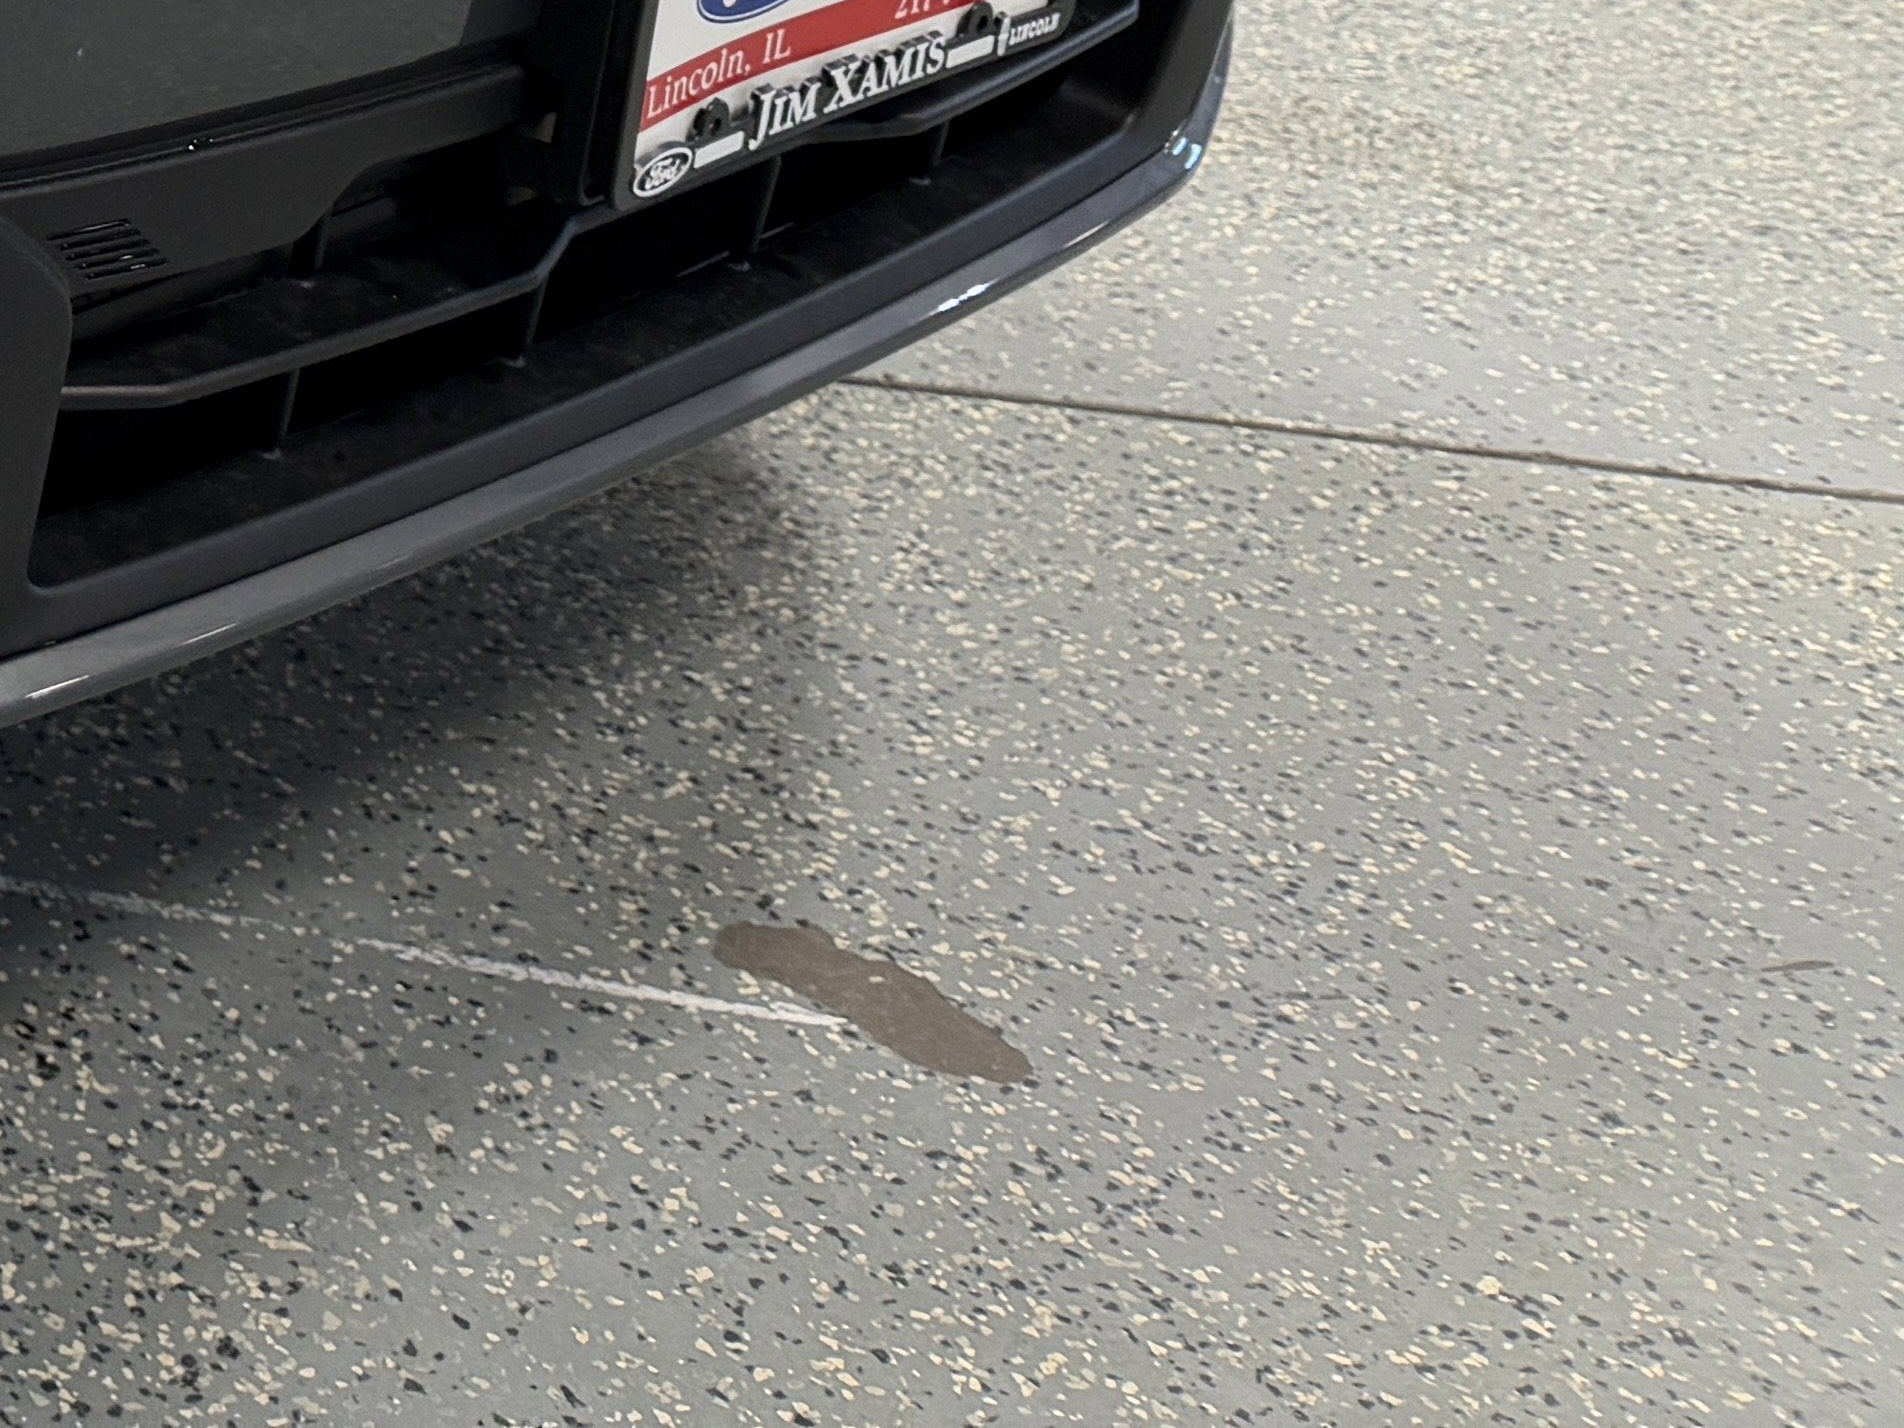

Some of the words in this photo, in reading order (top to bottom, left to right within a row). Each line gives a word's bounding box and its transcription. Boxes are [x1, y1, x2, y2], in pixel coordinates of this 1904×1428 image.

[645, 47, 751, 119] Lincoln,
[761, 28, 792, 63] IL
[748, 82, 822, 151] JIM
[823, 37, 948, 113] XAMIS
